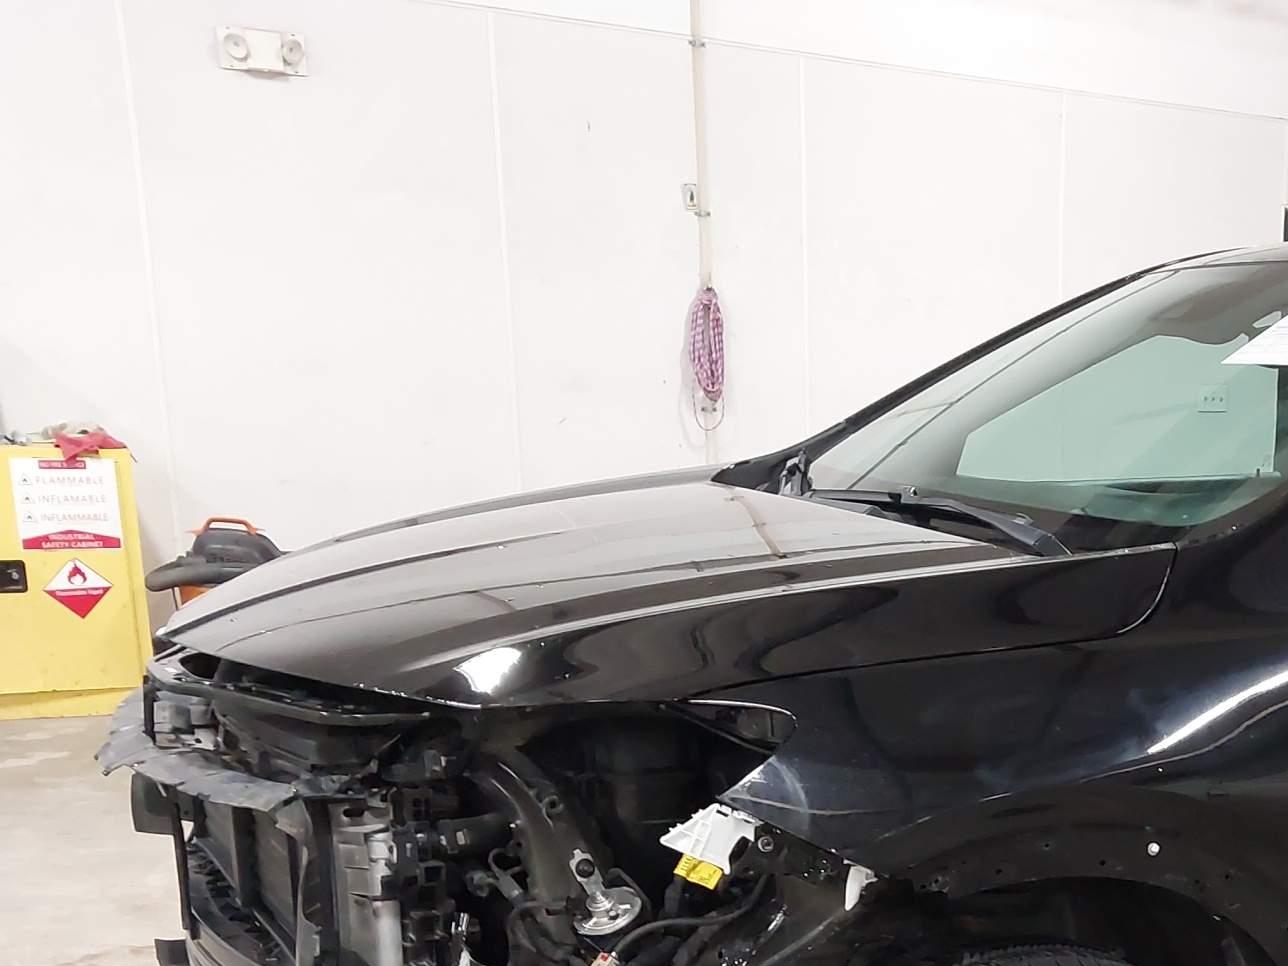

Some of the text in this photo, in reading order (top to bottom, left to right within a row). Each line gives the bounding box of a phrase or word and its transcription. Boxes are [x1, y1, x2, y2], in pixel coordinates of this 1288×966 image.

[36, 476, 104, 485] FLAMMABLE
[38, 495, 106, 504] INFLAMABLE
[40, 513, 109, 522] INFLAMMABLE
